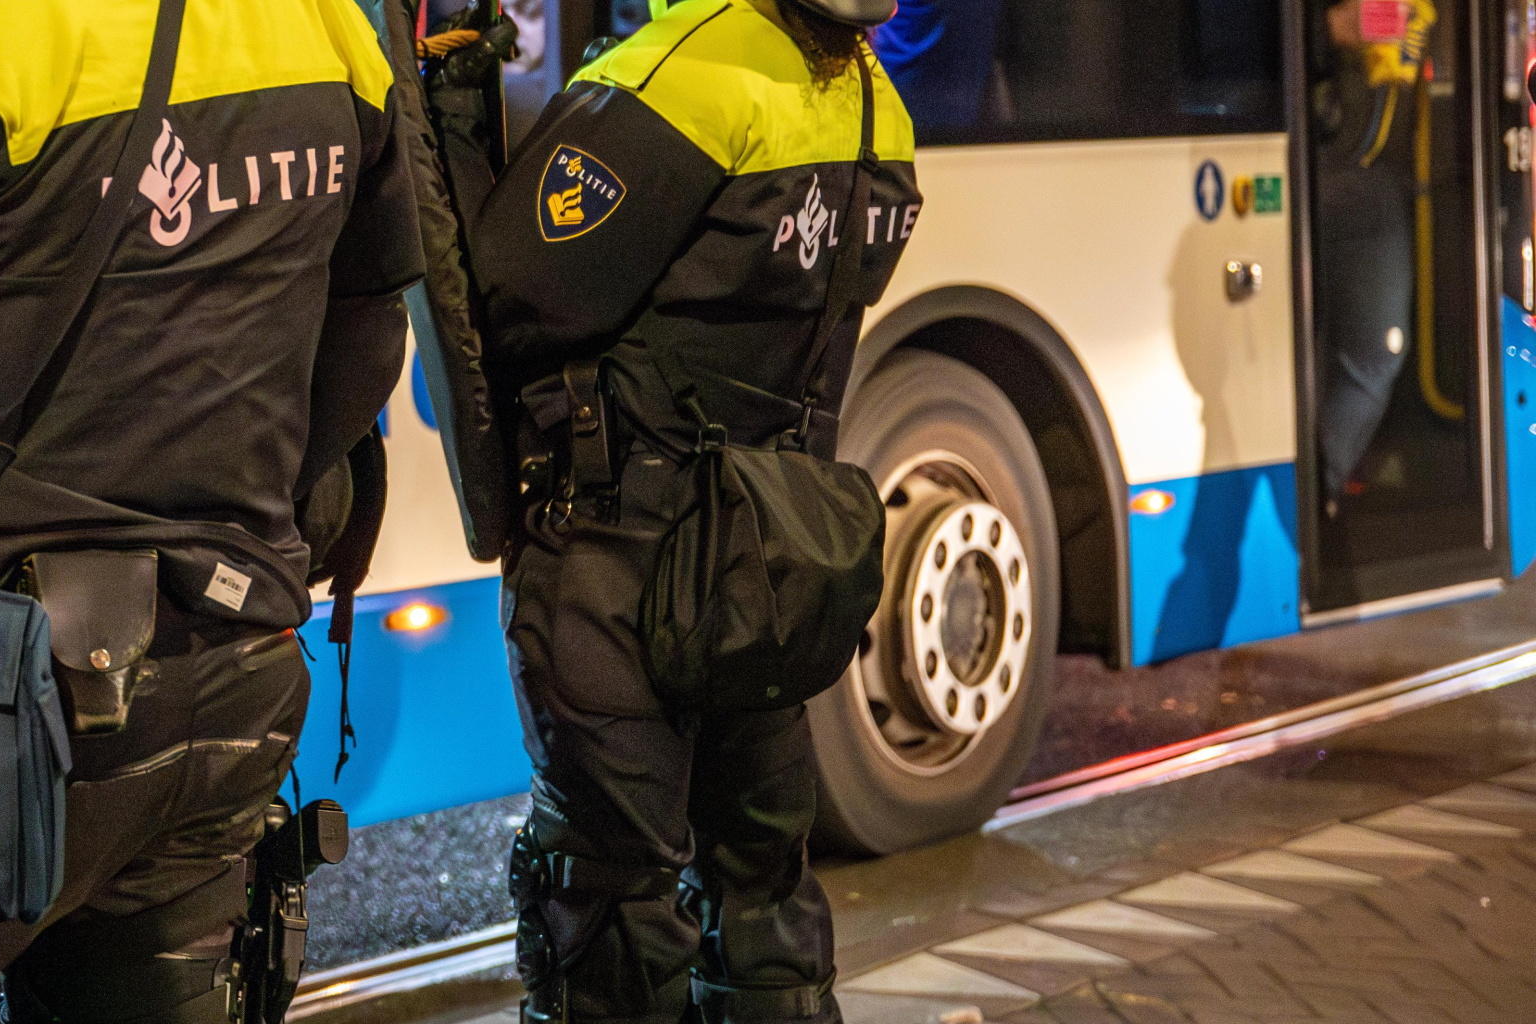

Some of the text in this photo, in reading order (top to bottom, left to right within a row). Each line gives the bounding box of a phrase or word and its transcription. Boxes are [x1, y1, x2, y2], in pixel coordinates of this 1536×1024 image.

[101, 118, 344, 247] OLITIE
[557, 154, 617, 200] POLITIE
[772, 173, 920, 270] POLTIE
